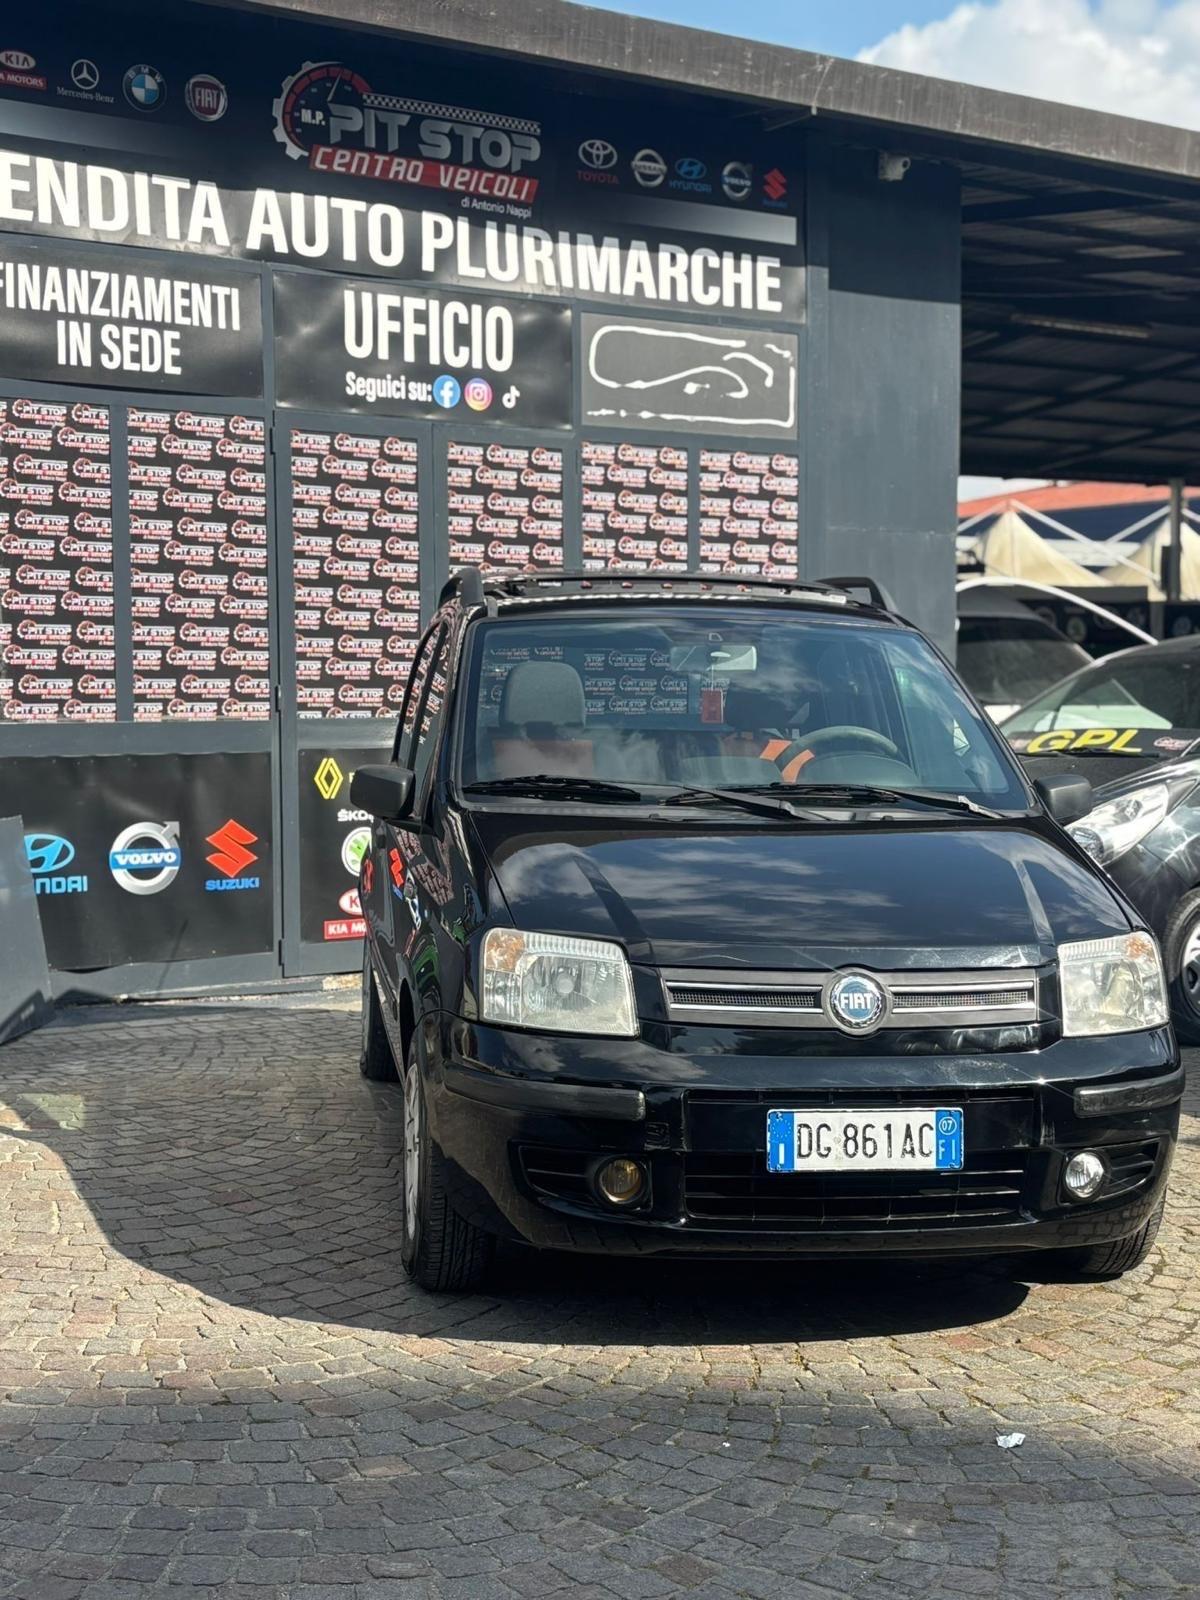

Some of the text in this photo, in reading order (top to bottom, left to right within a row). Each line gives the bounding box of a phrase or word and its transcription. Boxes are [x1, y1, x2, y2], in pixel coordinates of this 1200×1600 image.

[5, 53, 30, 66] KIA
[7, 74, 44, 87] MOTORS
[56, 86, 115, 103] Mercedes-Benz
[194, 87, 218, 110] FIAT
[301, 108, 326, 126] M.P.
[328, 102, 541, 173] PIT STOP
[576, 170, 619, 185] TOYOTA
[670, 180, 712, 193] HYUNDAI
[461, 198, 532, 219] di Antonio Nappi
[246, 187, 404, 267] AUTO
[422, 210, 782, 312] PLURIMARCHE
[344, 290, 514, 372] UFFICIO
[56, 320, 182, 375] IN SEDE
[345, 371, 432, 402] Seguici su:
[1027, 729, 1142, 753] GPL
[114, 852, 176, 865] VOLVO
[205, 877, 260, 890] SUZUKI
[328, 922, 348, 934] KIA
[841, 992, 874, 1010] FIAT
[941, 1121, 953, 1132] 07
[797, 1123, 832, 1159] DG
